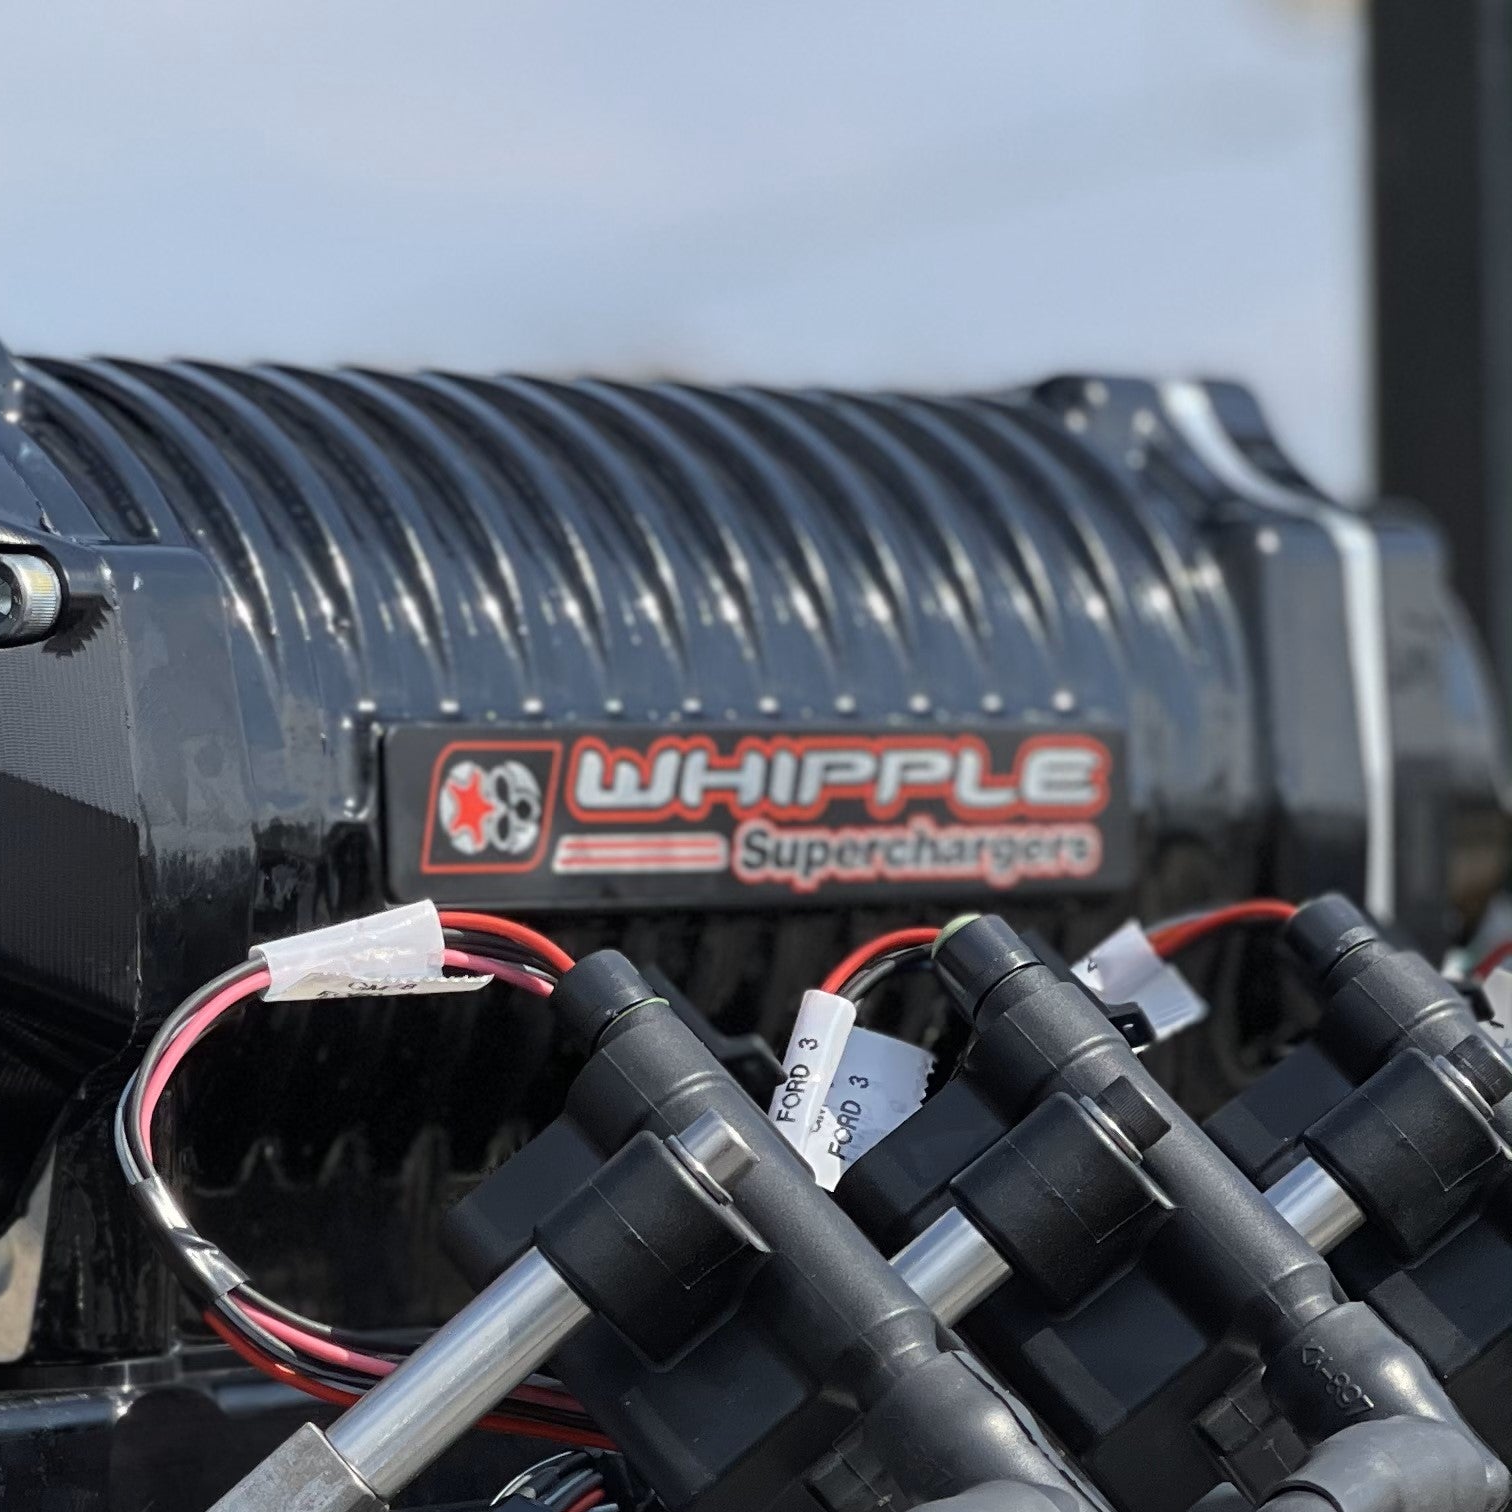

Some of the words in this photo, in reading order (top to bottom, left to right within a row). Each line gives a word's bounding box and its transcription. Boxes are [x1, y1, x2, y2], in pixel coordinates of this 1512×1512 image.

[569, 740, 1108, 819] WHIPPLE
[735, 819, 1101, 888] Superchargers
[776, 1063, 811, 1123] FORD
[798, 1037, 819, 1051] 3
[827, 1099, 863, 1161] FORD
[848, 1075, 870, 1089] 3
